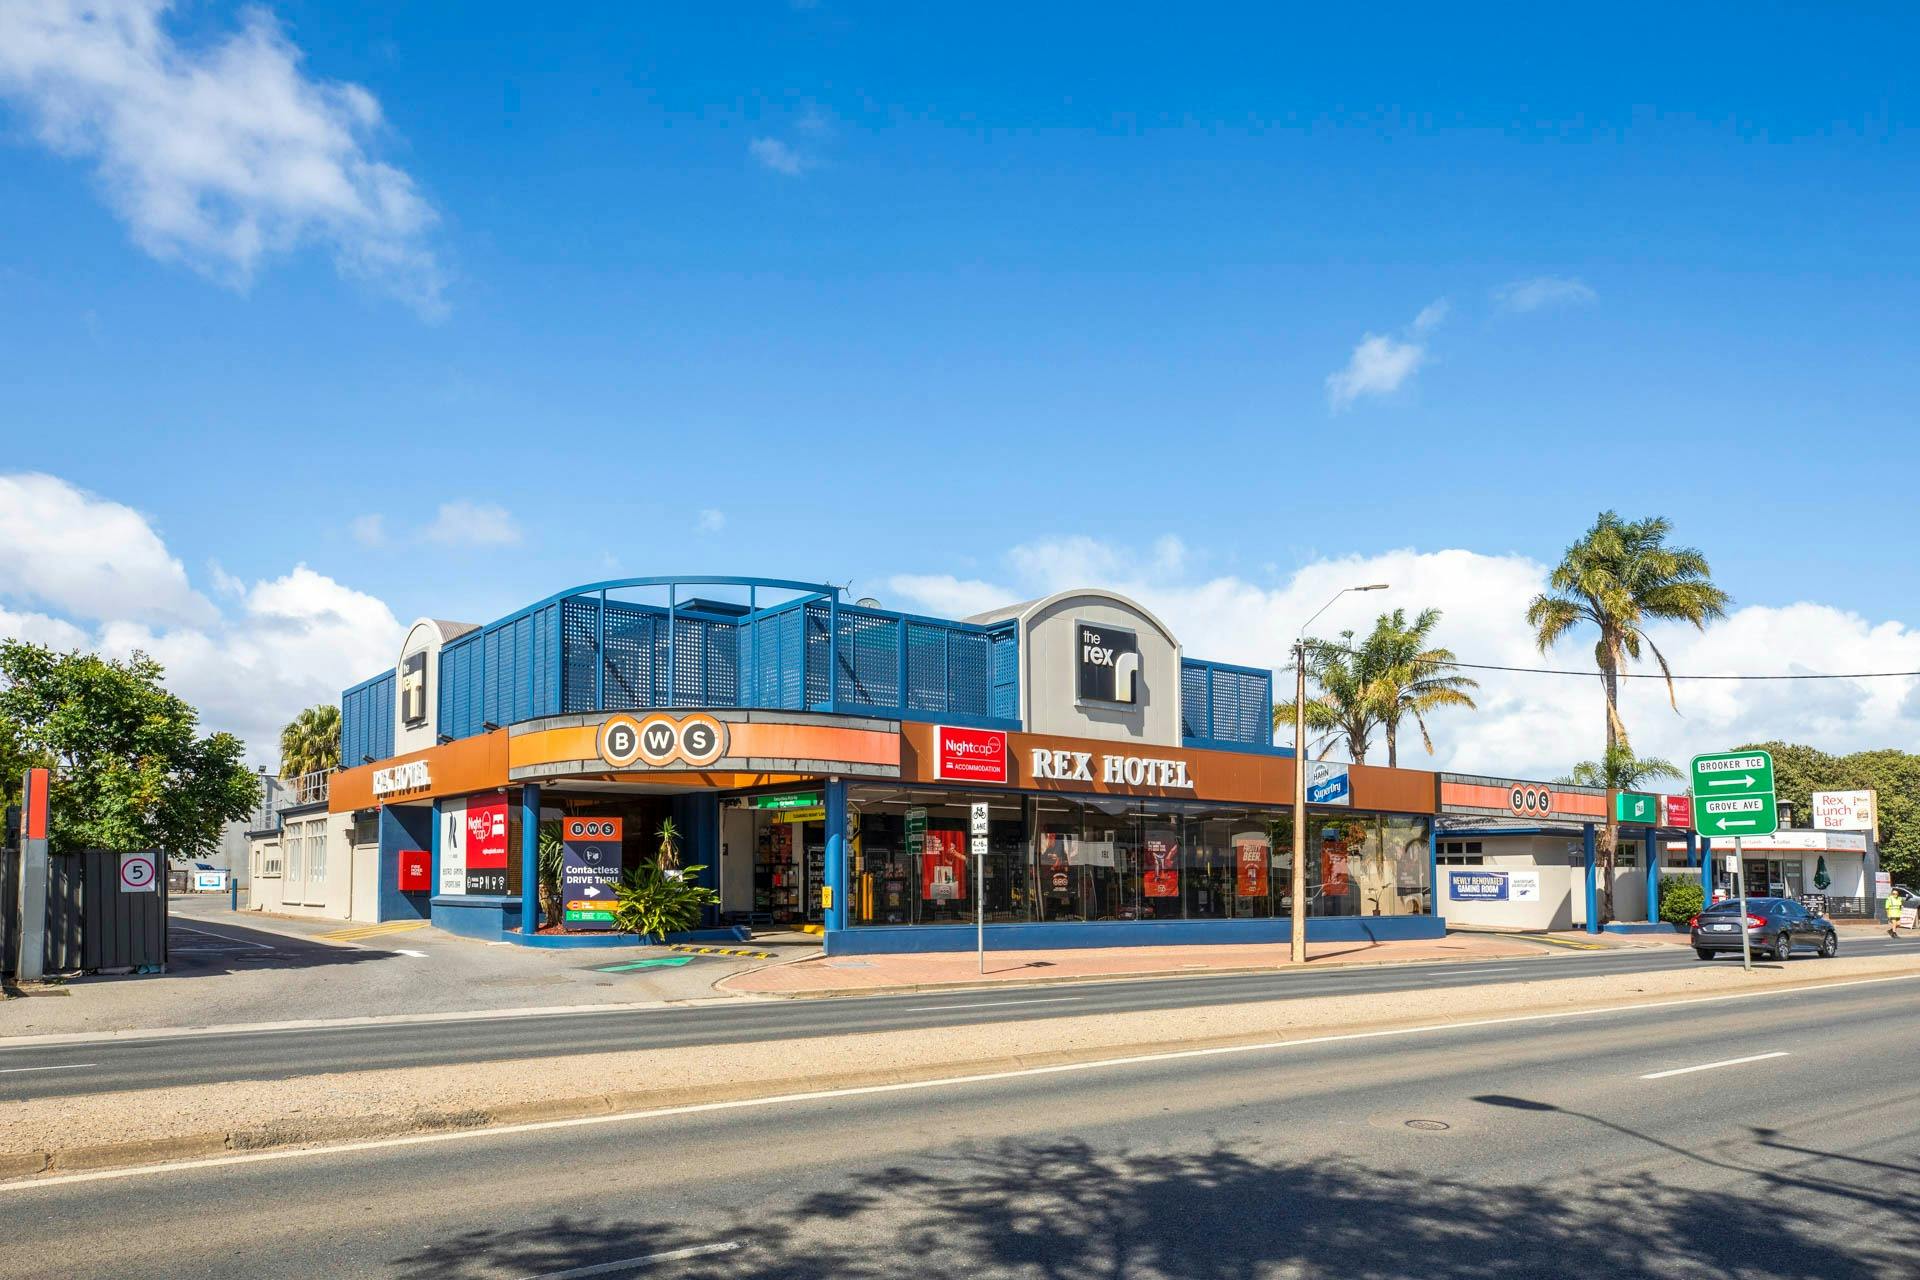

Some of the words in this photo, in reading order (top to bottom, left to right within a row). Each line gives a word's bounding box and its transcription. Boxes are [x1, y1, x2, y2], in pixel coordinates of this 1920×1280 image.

[1083, 630, 1101, 645] the
[1083, 645, 1114, 667] rex
[615, 731, 707, 751] BWS
[945, 739, 993, 756] Nightcap
[955, 763, 1001, 773] ACCOMMODATION
[1032, 748, 1094, 782] REX
[1102, 754, 1194, 789] HOTEL
[1700, 760, 1740, 771] BROOKER
[1745, 758, 1762, 767] TCE
[1313, 768, 1329, 781] HAHN
[1515, 794, 1547, 807] BWS
[1822, 795, 1844, 804] Rex
[1709, 802, 1738, 811] GROVE
[1743, 800, 1760, 809] AVE
[1816, 805, 1852, 816] Lunch
[972, 823, 986, 831] LANE
[1824, 816, 1844, 827] Bar
[575, 825, 612, 833] BWS
[132, 865, 144, 880] 5
[566, 865, 619, 874] Contactless
[566, 876, 593, 884] DRIVE
[595, 876, 618, 884] THRU
[1453, 876, 1471, 885] NEWLY
[1471, 876, 1504, 885] RENOVATED
[1457, 885, 1480, 893] GAMING
[1481, 885, 1499, 894] ROOM
